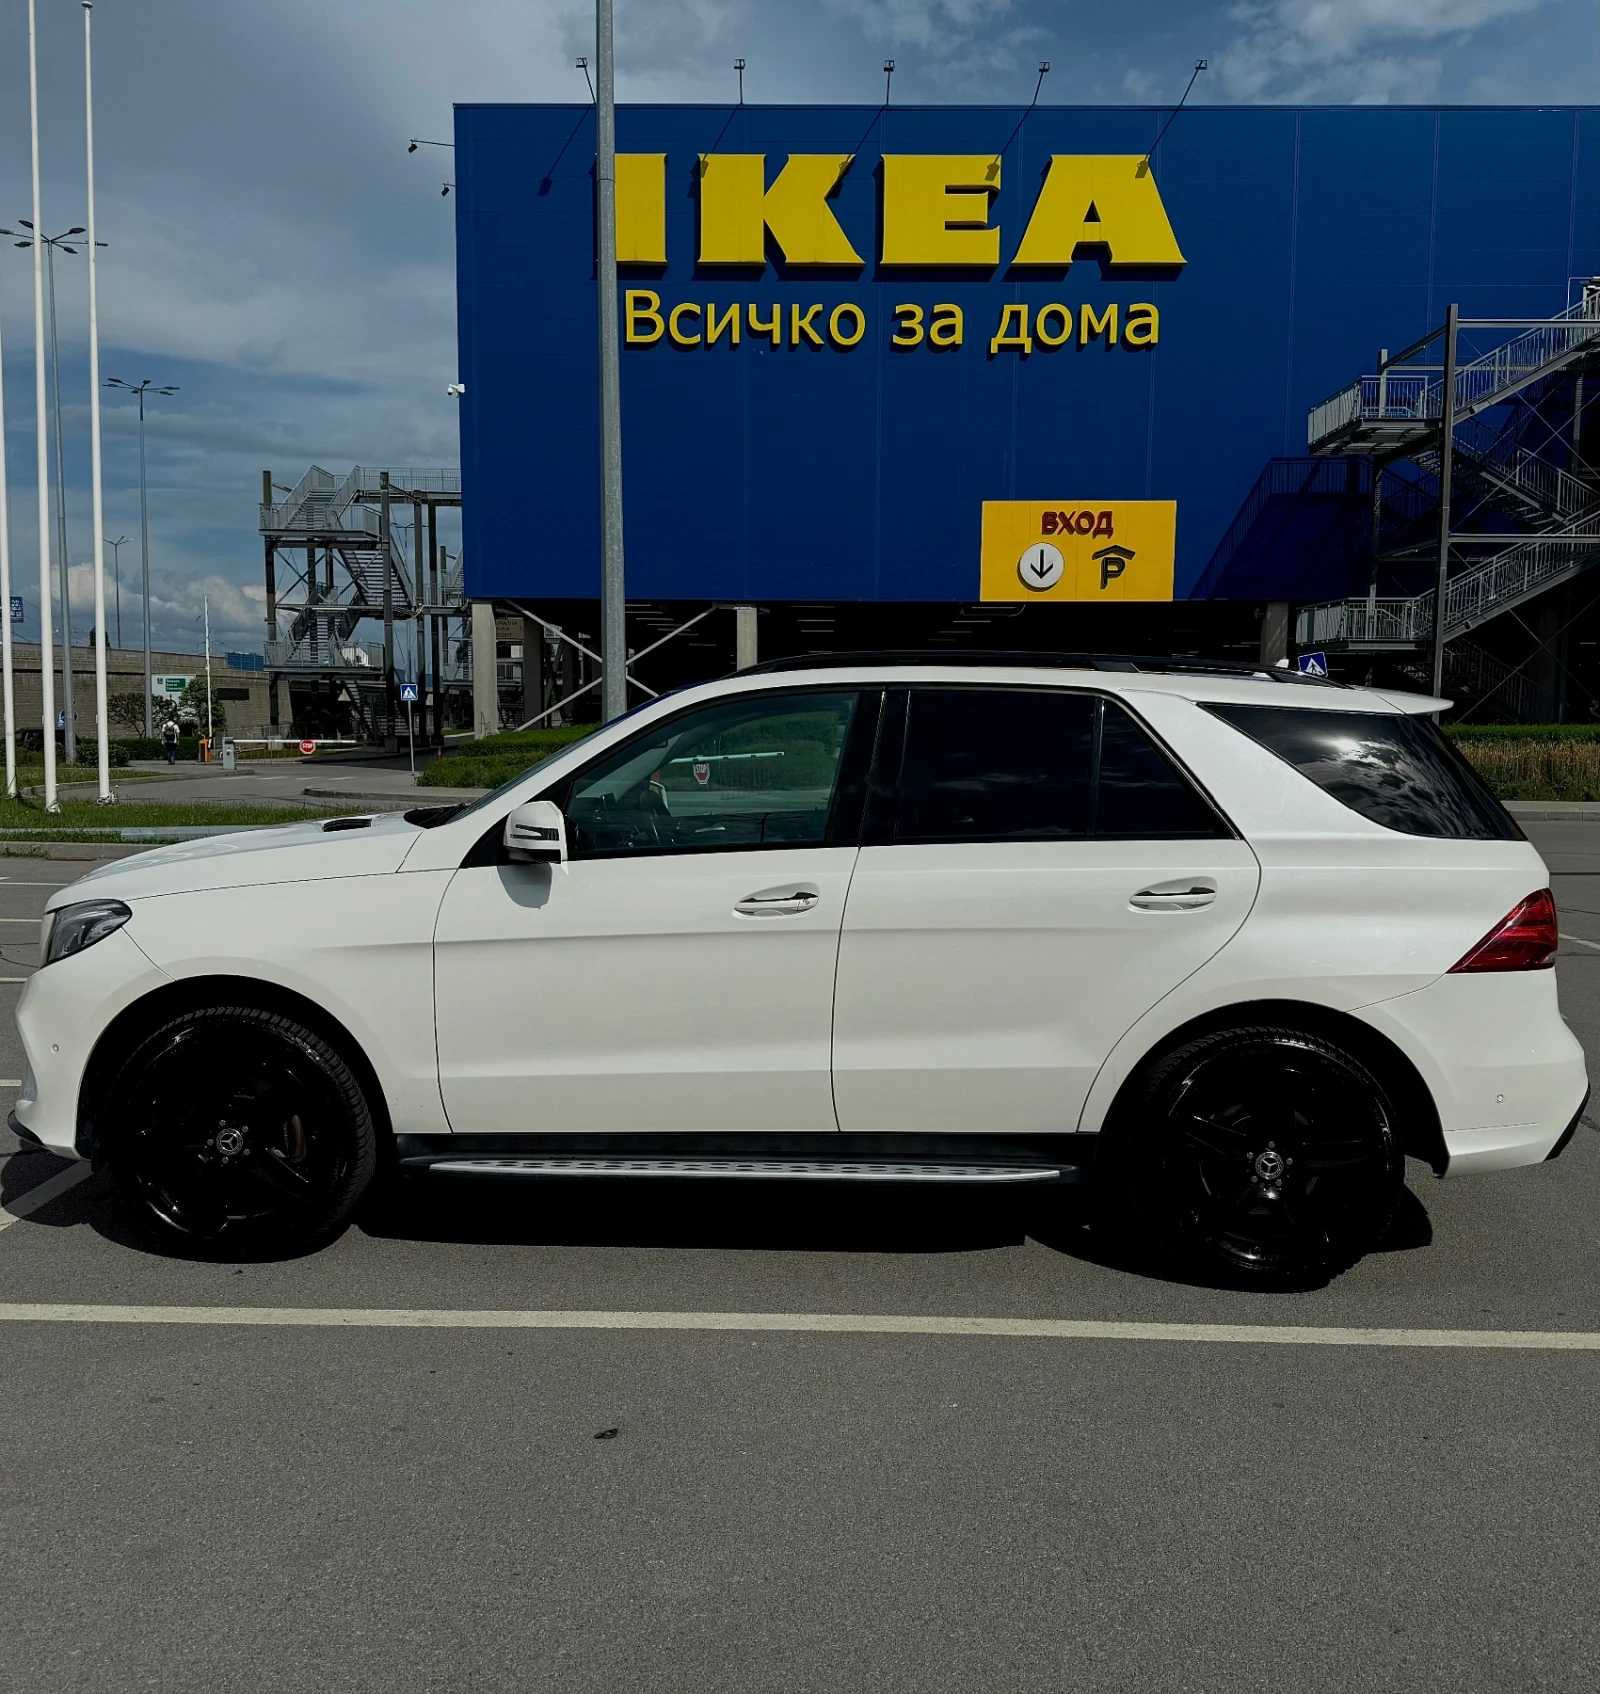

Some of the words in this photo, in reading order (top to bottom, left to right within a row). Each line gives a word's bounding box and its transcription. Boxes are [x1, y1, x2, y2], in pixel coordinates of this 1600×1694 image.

[614, 153, 1188, 267] IKEA
[625, 289, 866, 345] Всичко
[892, 303, 964, 345] за
[990, 303, 1160, 354] дома
[1041, 510, 1114, 540] ВХОД
[695, 764, 707, 773] STOP
